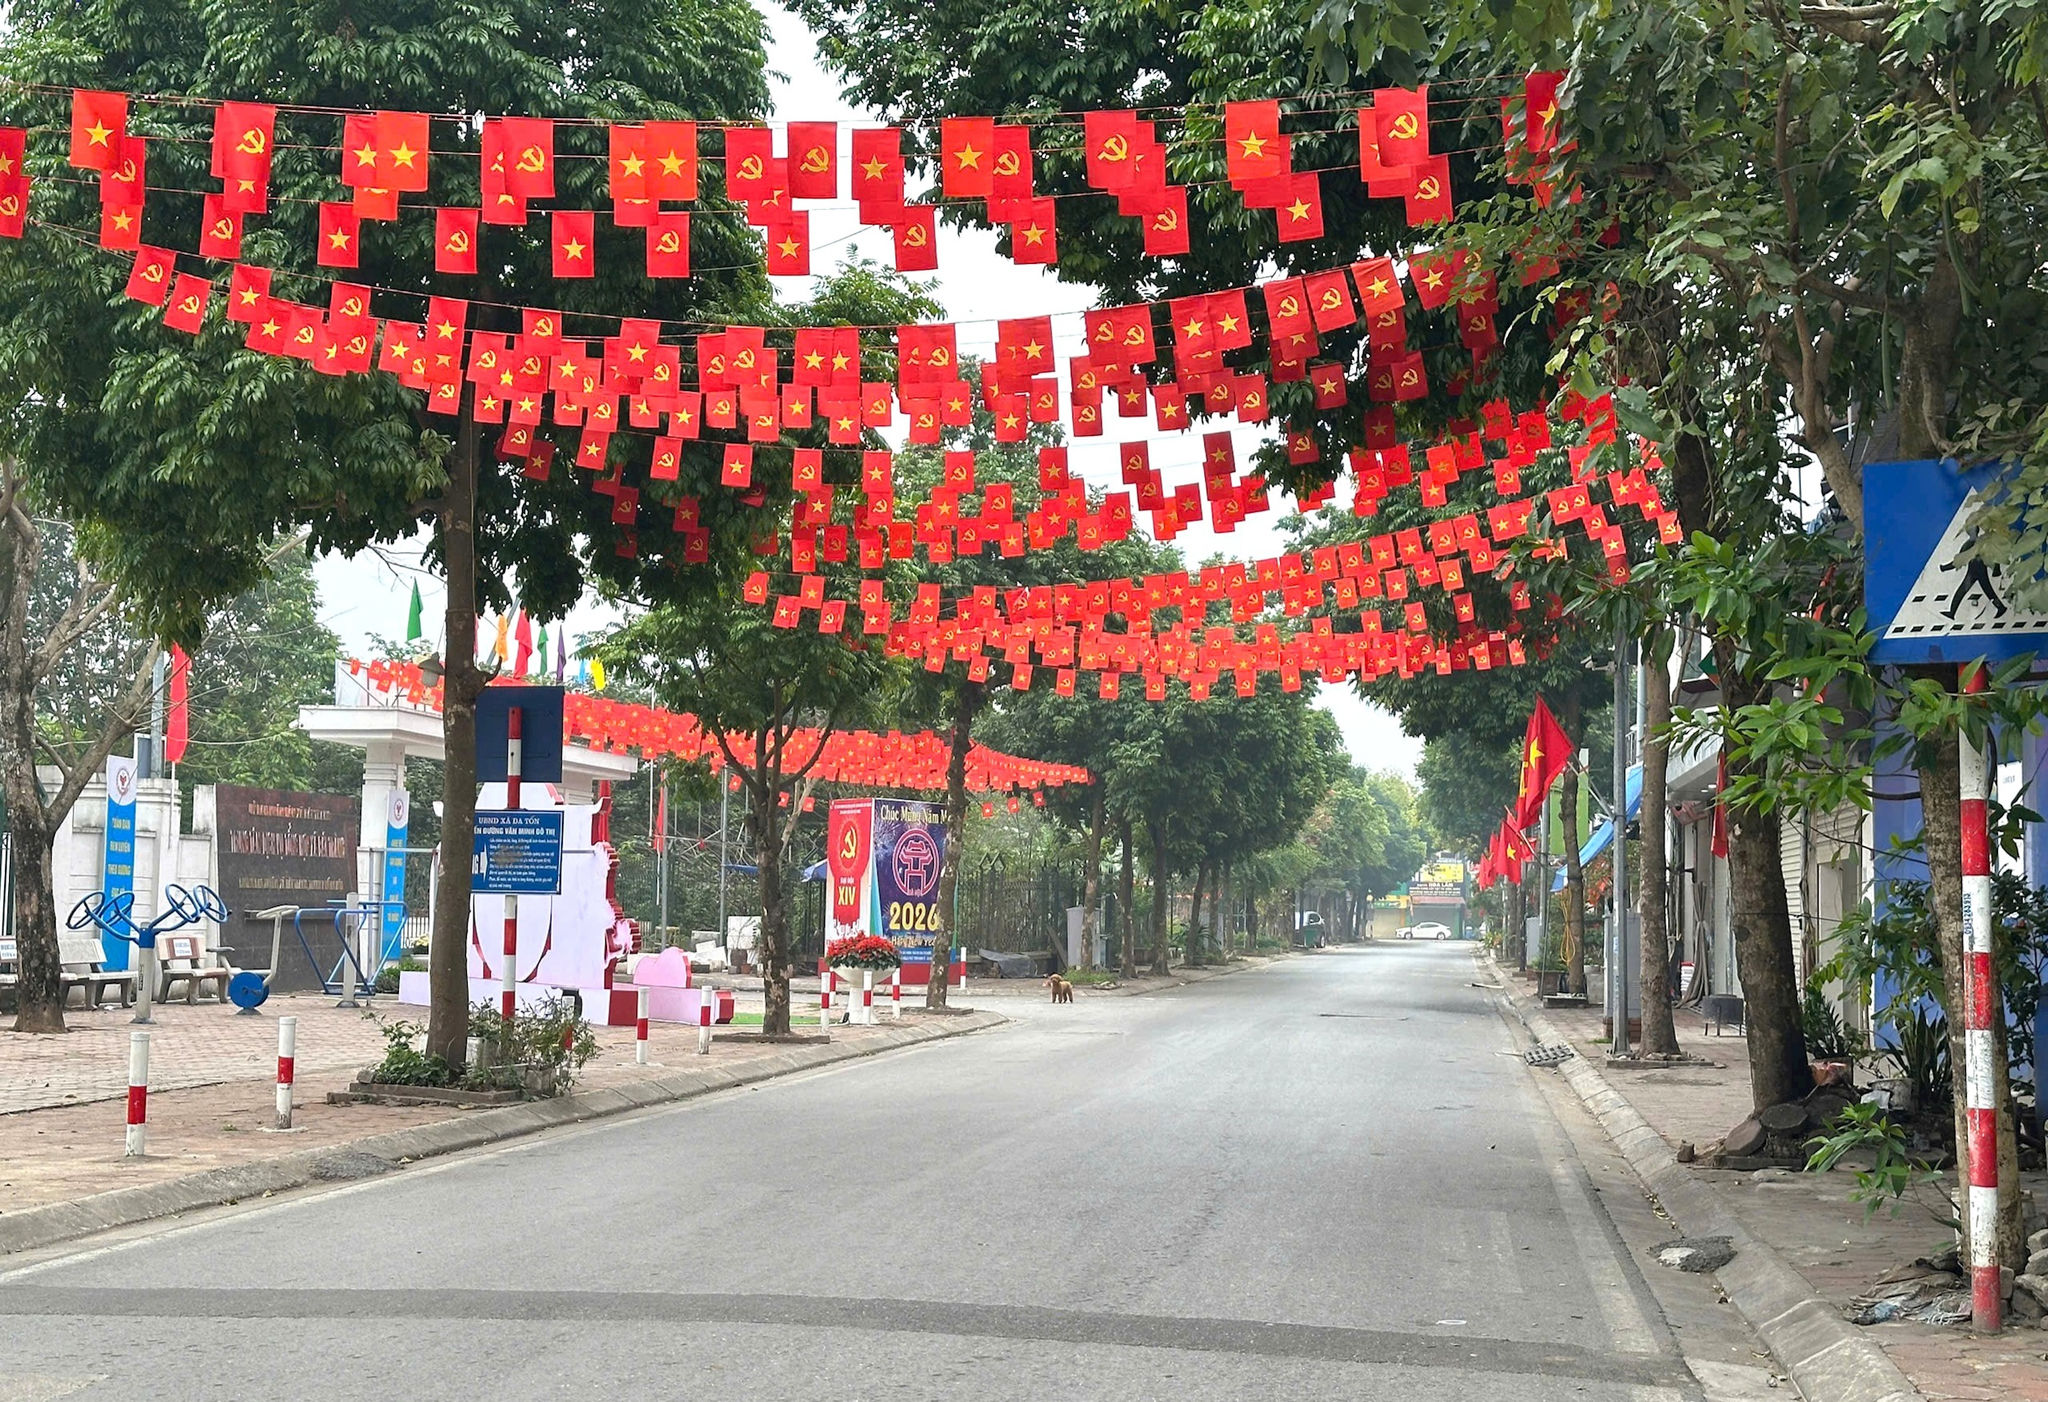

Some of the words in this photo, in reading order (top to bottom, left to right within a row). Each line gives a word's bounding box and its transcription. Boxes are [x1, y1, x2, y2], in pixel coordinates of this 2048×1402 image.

[478, 816, 499, 825] UBND
[838, 885, 856, 905] XIV
[889, 901, 939, 931] 2026
